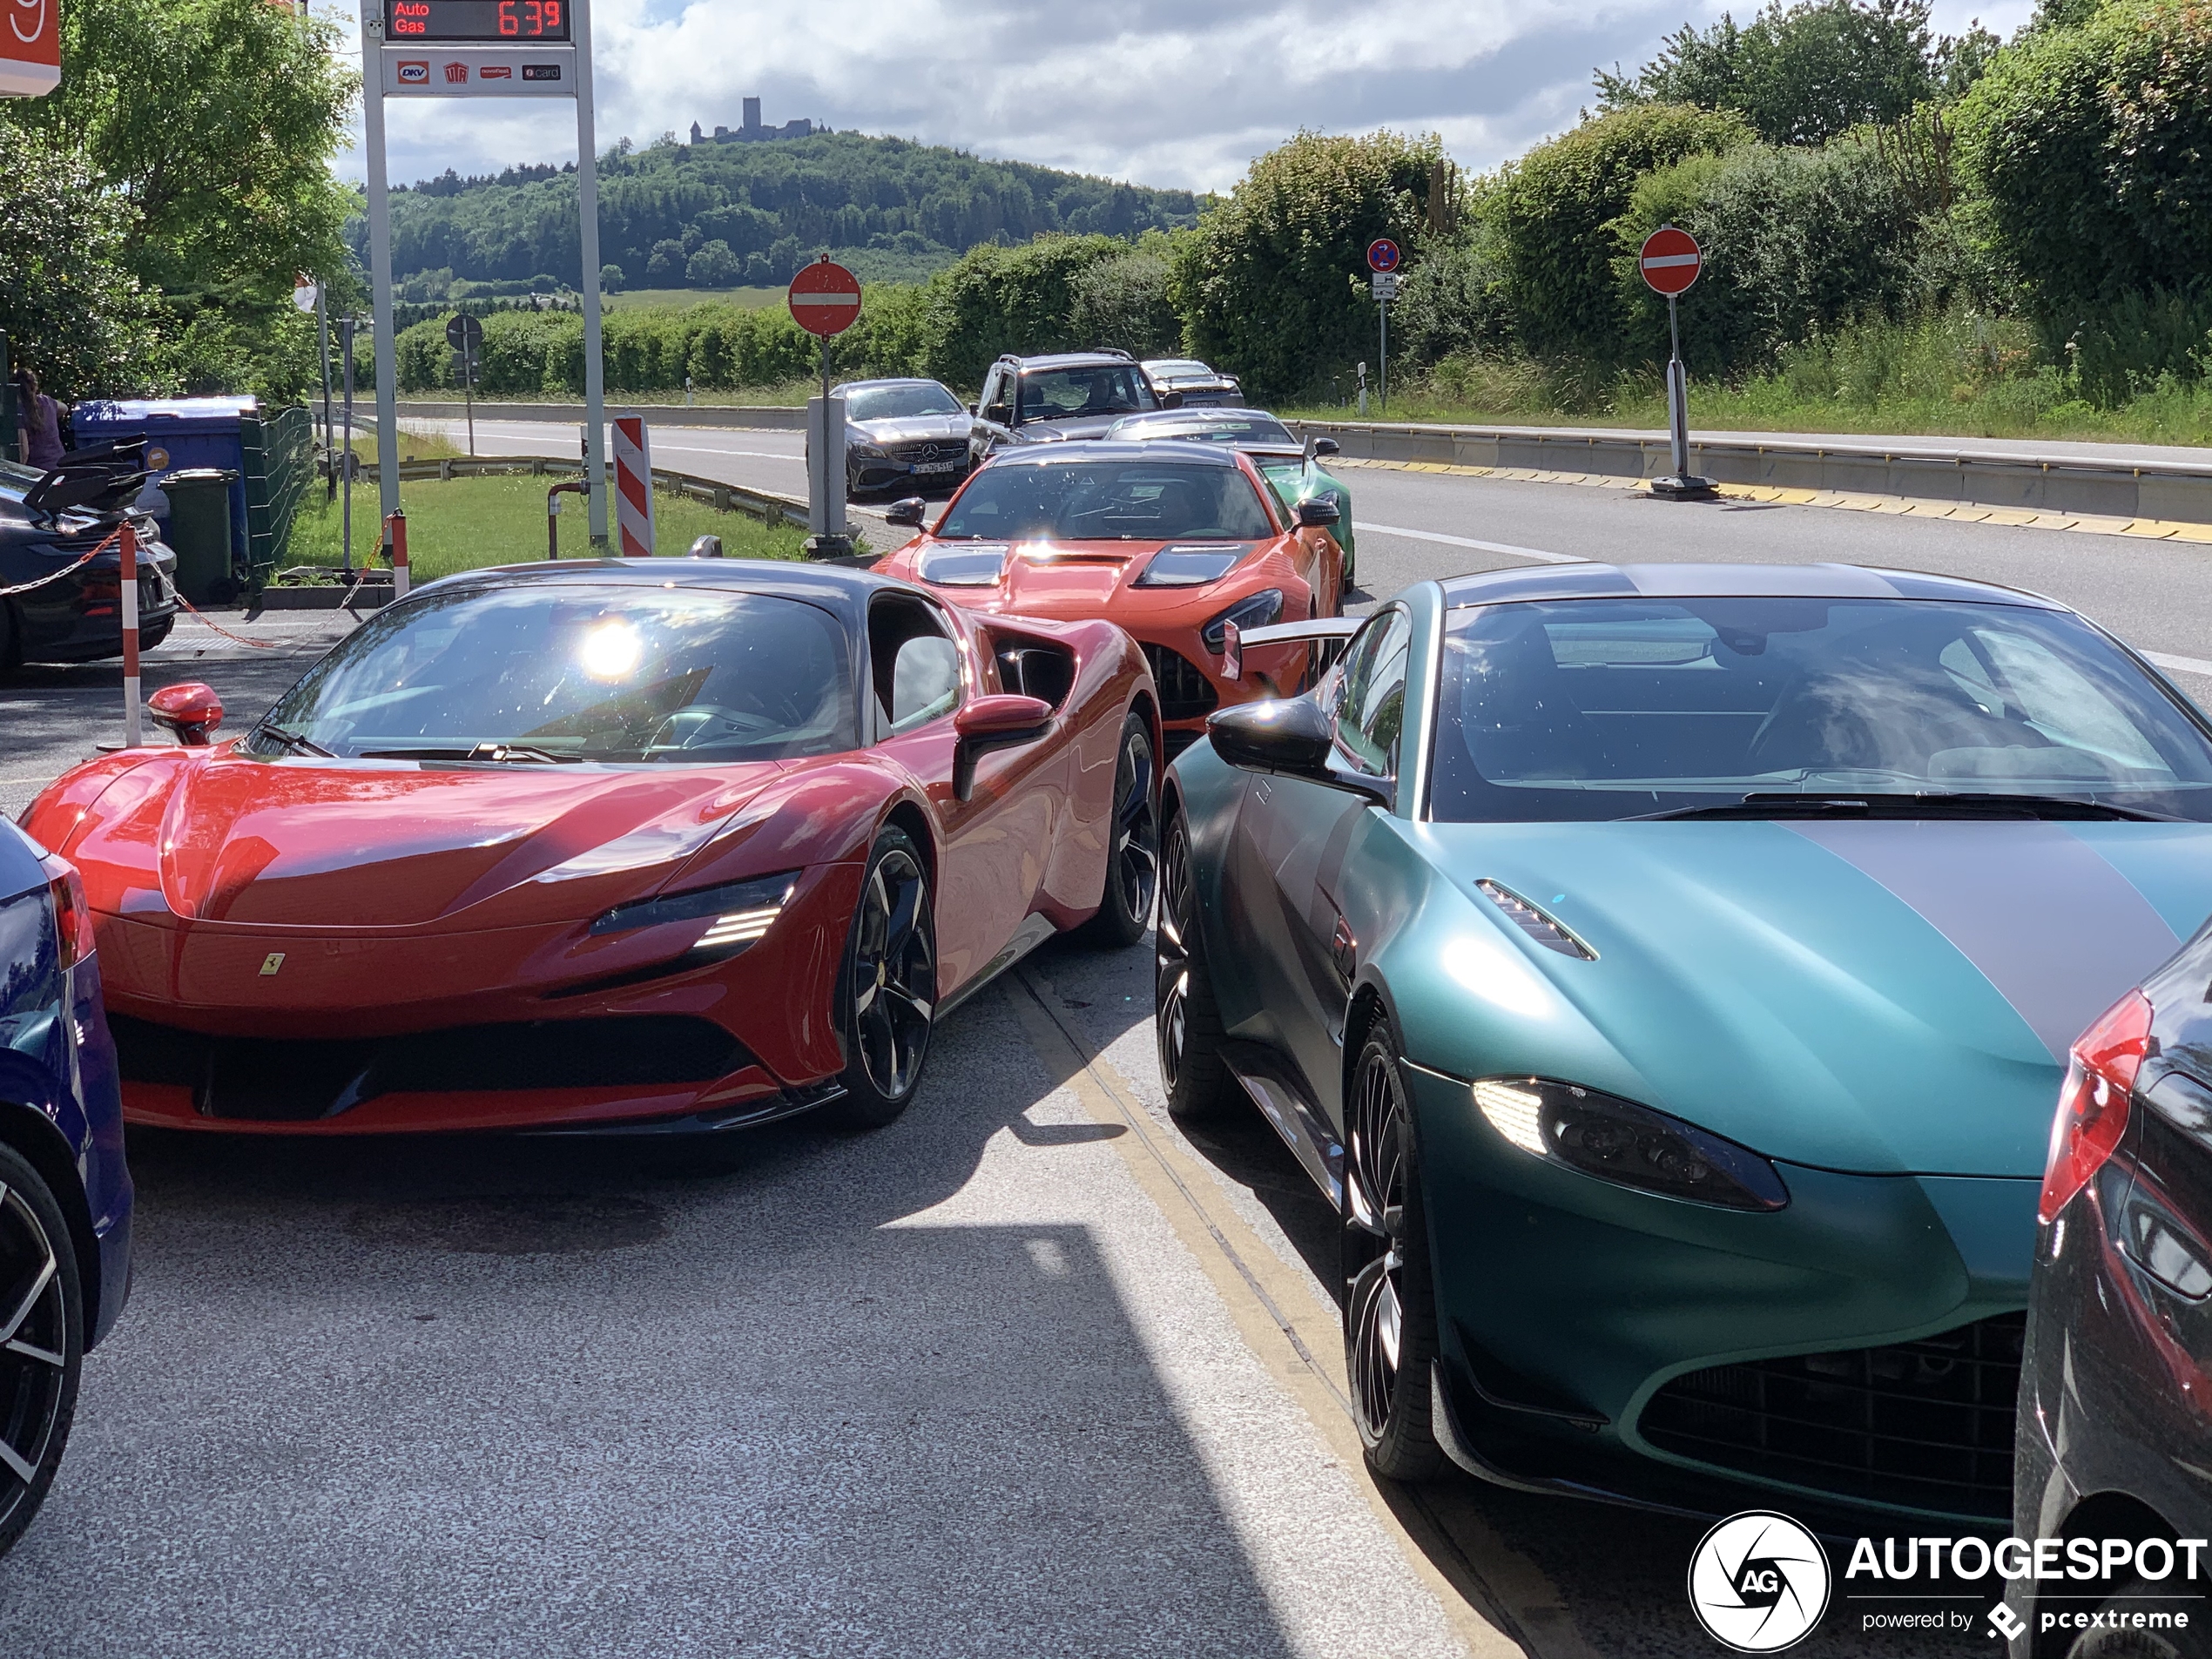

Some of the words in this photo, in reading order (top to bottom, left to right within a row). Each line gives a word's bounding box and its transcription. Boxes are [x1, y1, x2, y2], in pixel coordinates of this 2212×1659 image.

[395, 3, 429, 16] Auto
[499, 1, 560, 35] 639
[395, 19, 425, 33] Gas
